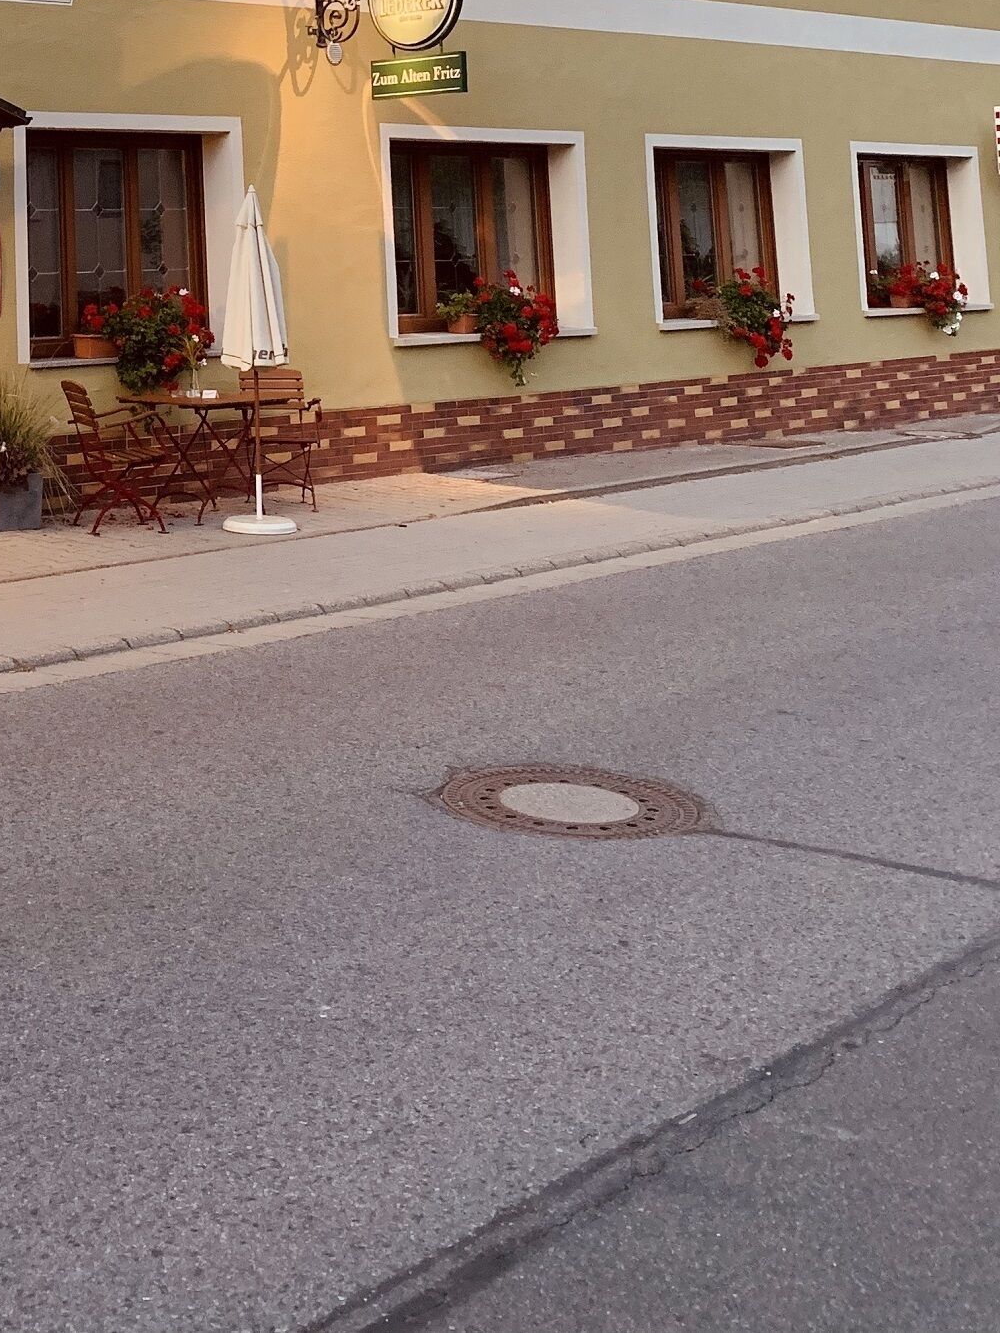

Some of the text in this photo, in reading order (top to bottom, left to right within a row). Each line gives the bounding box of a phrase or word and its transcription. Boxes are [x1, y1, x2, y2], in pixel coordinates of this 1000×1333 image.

[372, 65, 461, 87] Zum Alten Fritz
